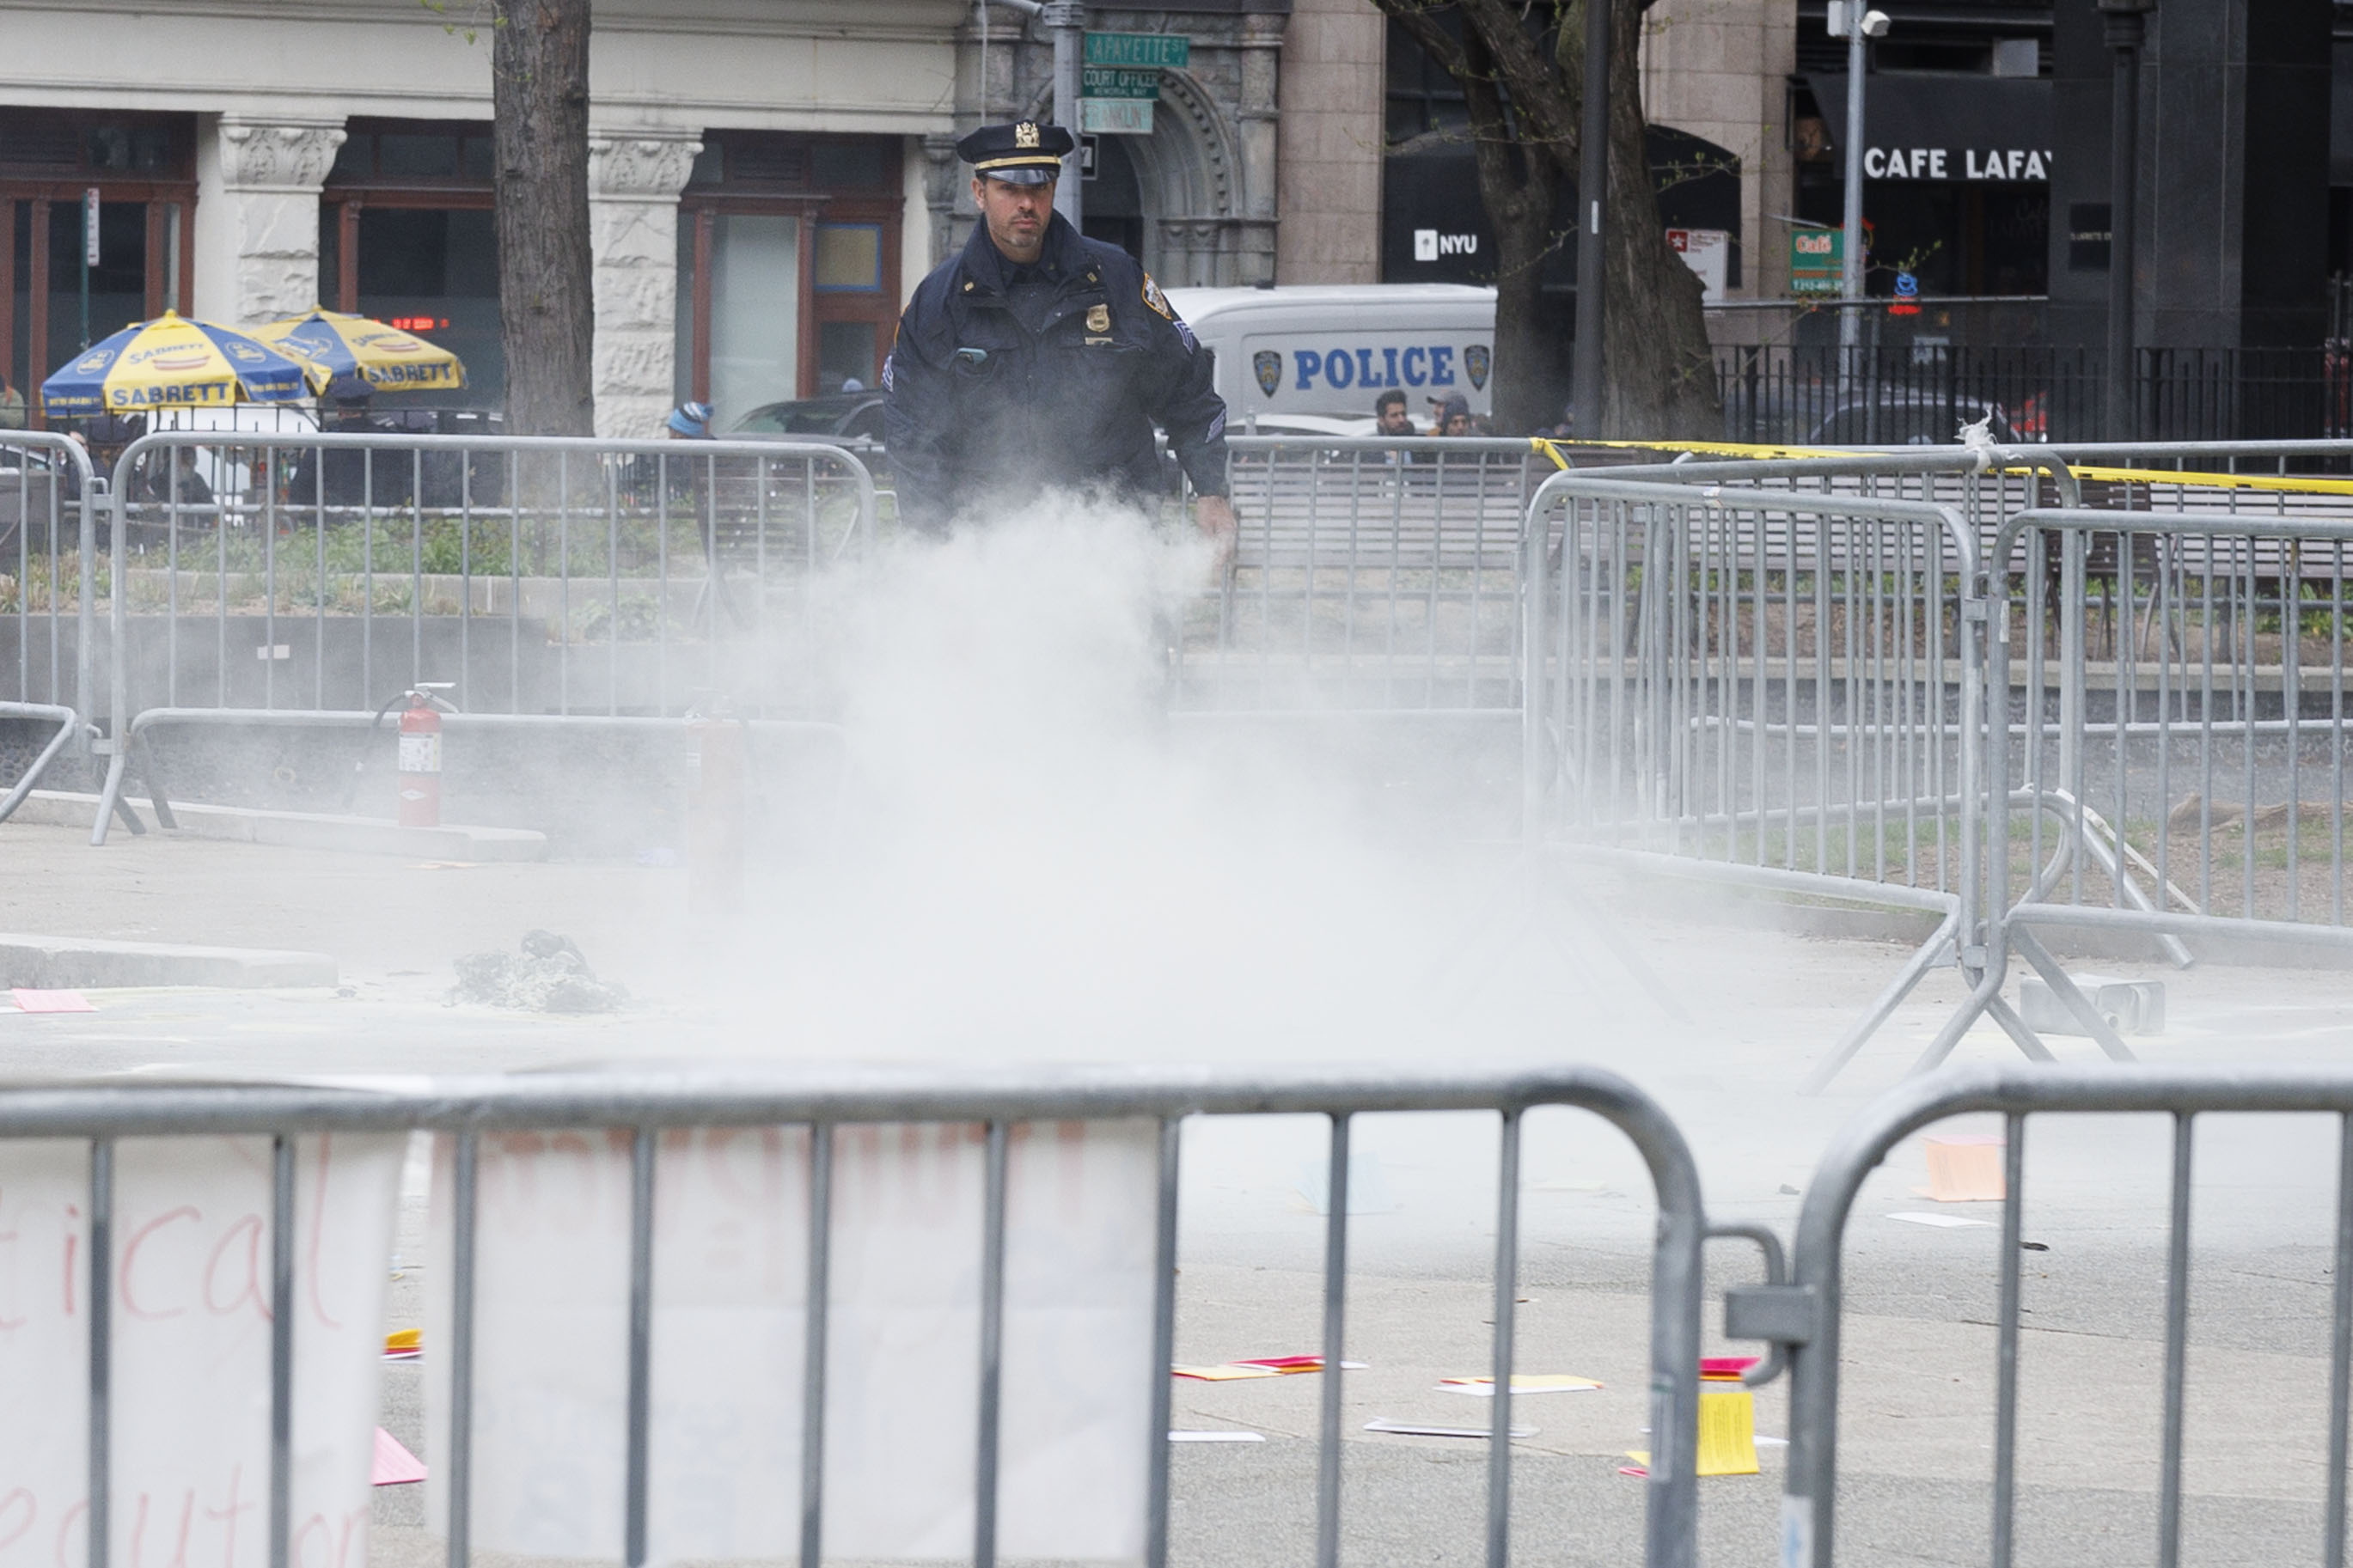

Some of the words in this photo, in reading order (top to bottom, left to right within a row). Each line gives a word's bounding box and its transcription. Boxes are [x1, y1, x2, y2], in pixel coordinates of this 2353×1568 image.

[1084, 36, 1170, 63] LAFAYETTE
[1084, 70, 1116, 86] COURT
[1118, 70, 1158, 88] OFFICER
[1864, 147, 1948, 179] CAFE
[1439, 234, 1477, 255] NYU
[1795, 235, 1832, 254] Café
[129, 342, 205, 365] SABRETT
[367, 363, 452, 383] SABRETT
[1293, 346, 1455, 389] POLICE
[113, 381, 230, 407] SABRETT
